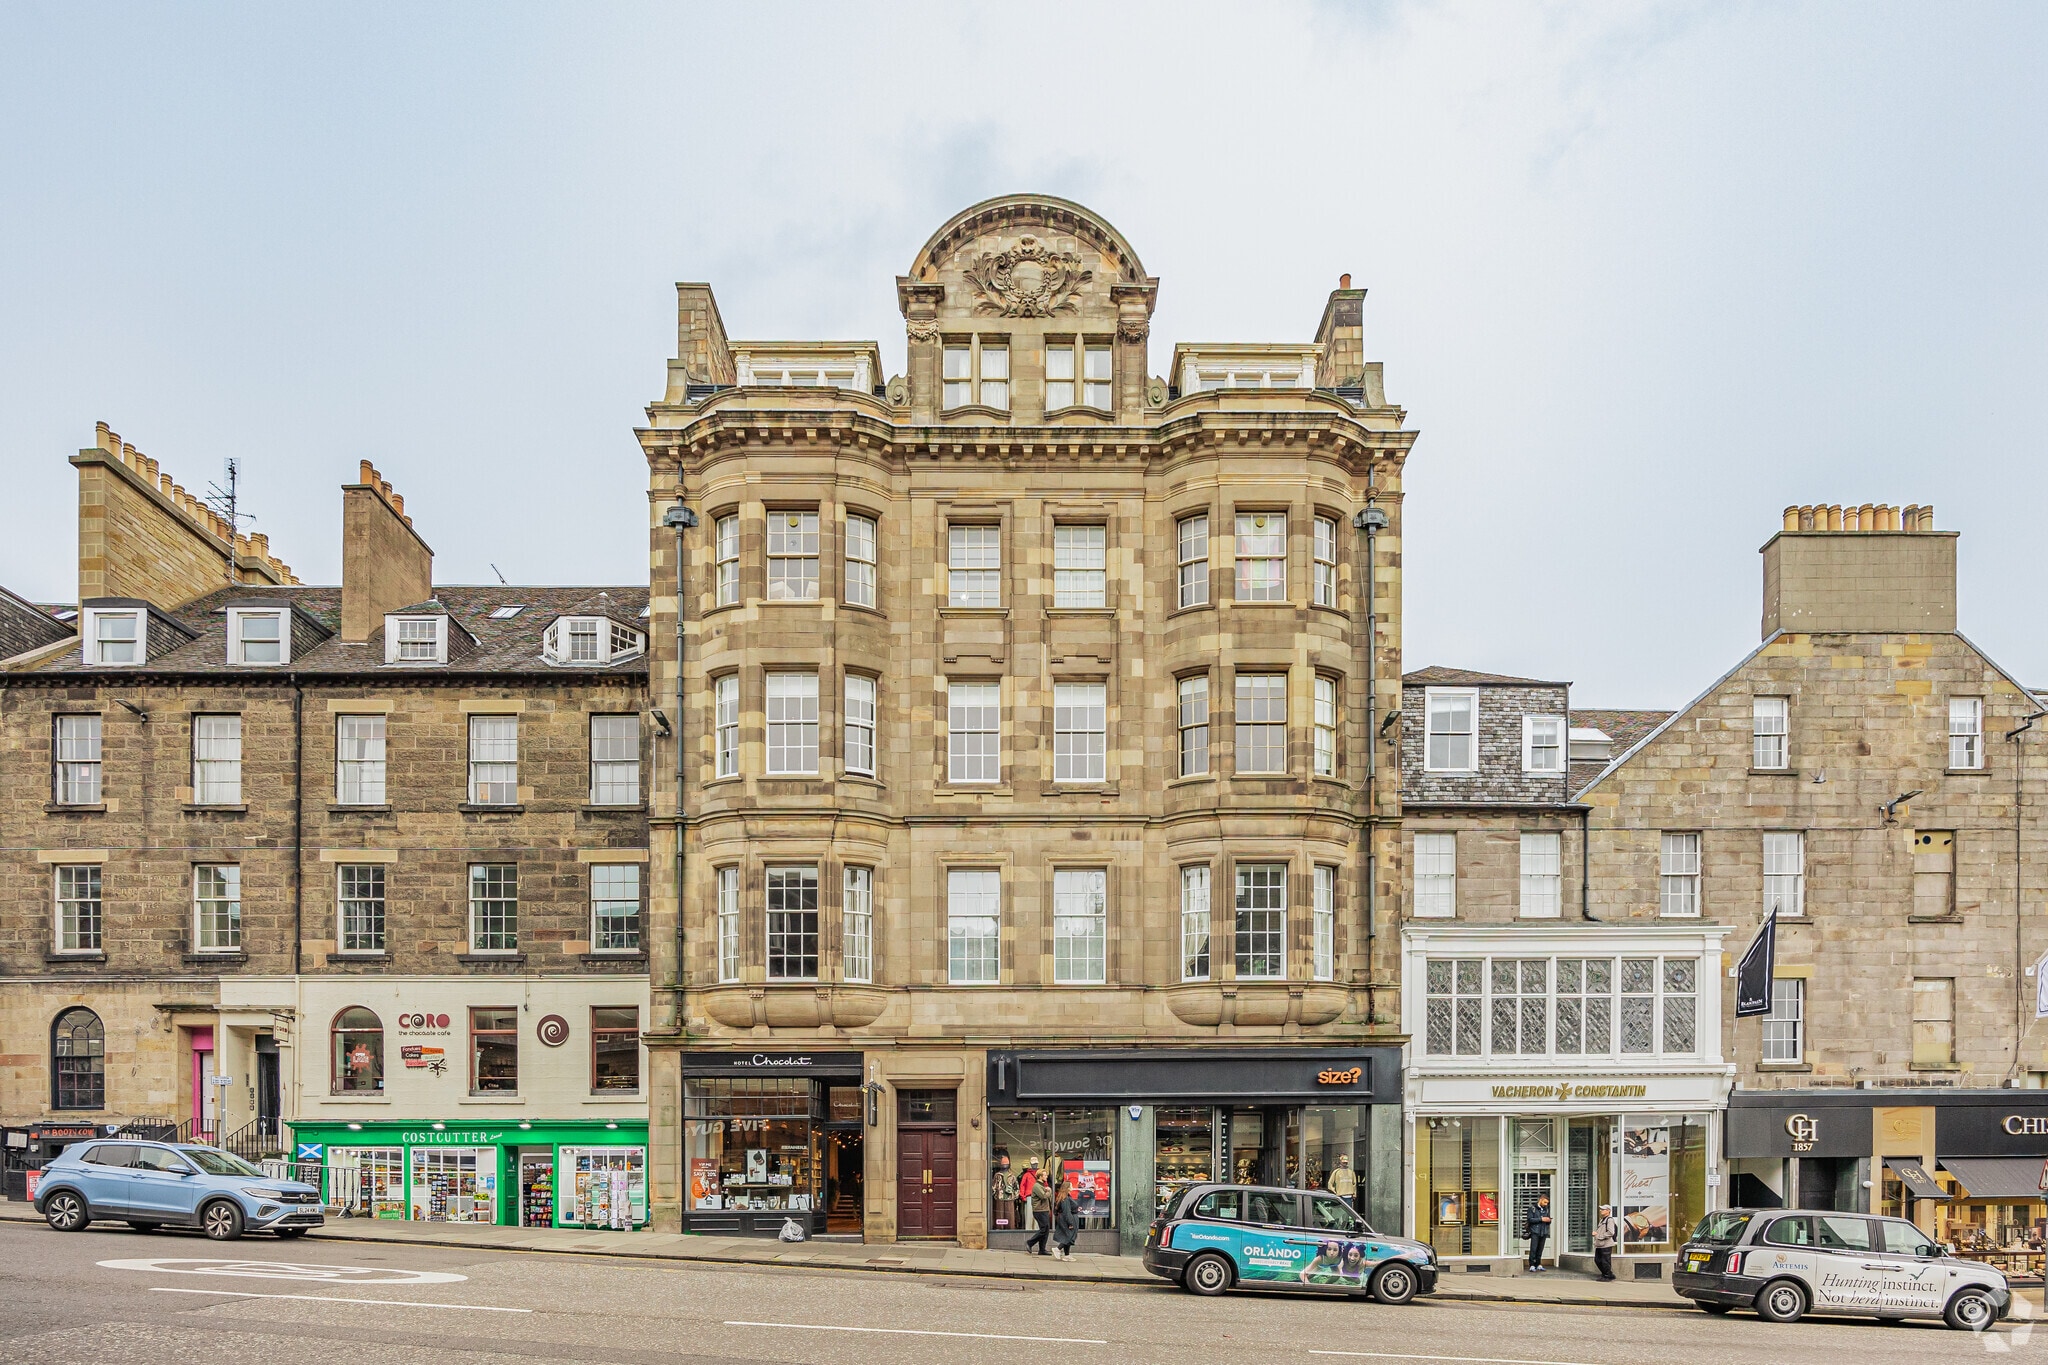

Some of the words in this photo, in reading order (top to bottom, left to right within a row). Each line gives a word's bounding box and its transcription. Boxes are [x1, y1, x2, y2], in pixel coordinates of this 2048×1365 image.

[398, 1013, 451, 1029] CORO
[1318, 1067, 1362, 1084] size?
[1491, 1085, 1554, 1097] VACHERON
[1574, 1085, 1647, 1097] CONSTANTIN
[925, 1103, 931, 1111] 7
[2001, 1115, 2048, 1135] CHI
[402, 1132, 488, 1142] COSTCUTTER
[1793, 1143, 1813, 1151] 1857
[1243, 1246, 1301, 1259] ORLANDO
[1772, 1261, 1809, 1270] ARTEMIS
[1822, 1273, 1880, 1293] Hunting
[1883, 1277, 1937, 1292] instinct.
[1818, 1289, 1845, 1303] Not
[1850, 1291, 1882, 1305] herd
[1885, 1294, 1939, 1308] instinct.
